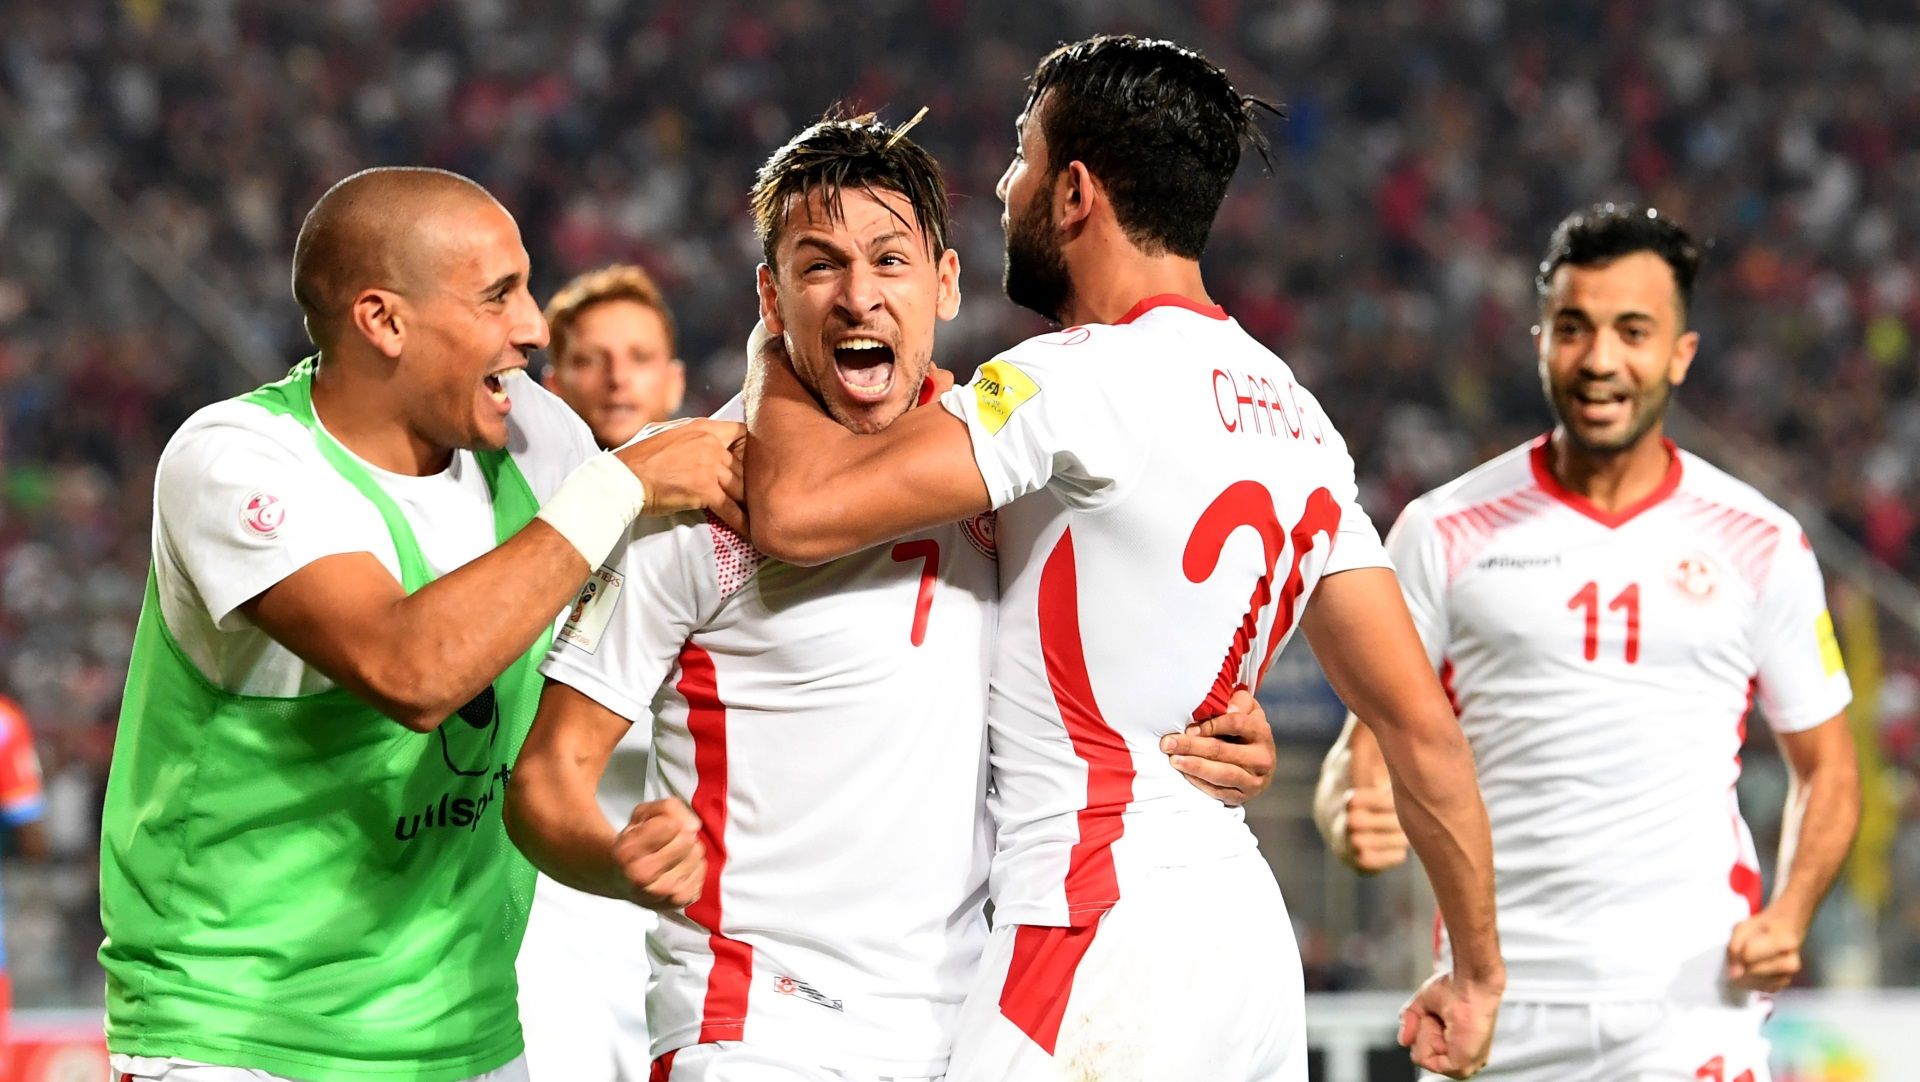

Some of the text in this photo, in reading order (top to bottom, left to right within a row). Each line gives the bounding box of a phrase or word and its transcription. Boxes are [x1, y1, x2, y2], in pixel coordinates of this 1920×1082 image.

[974, 377, 1001, 397] FIFA
[891, 538, 940, 648] 7
[1567, 581, 1640, 664] 11
[394, 762, 511, 841] ulsprt
